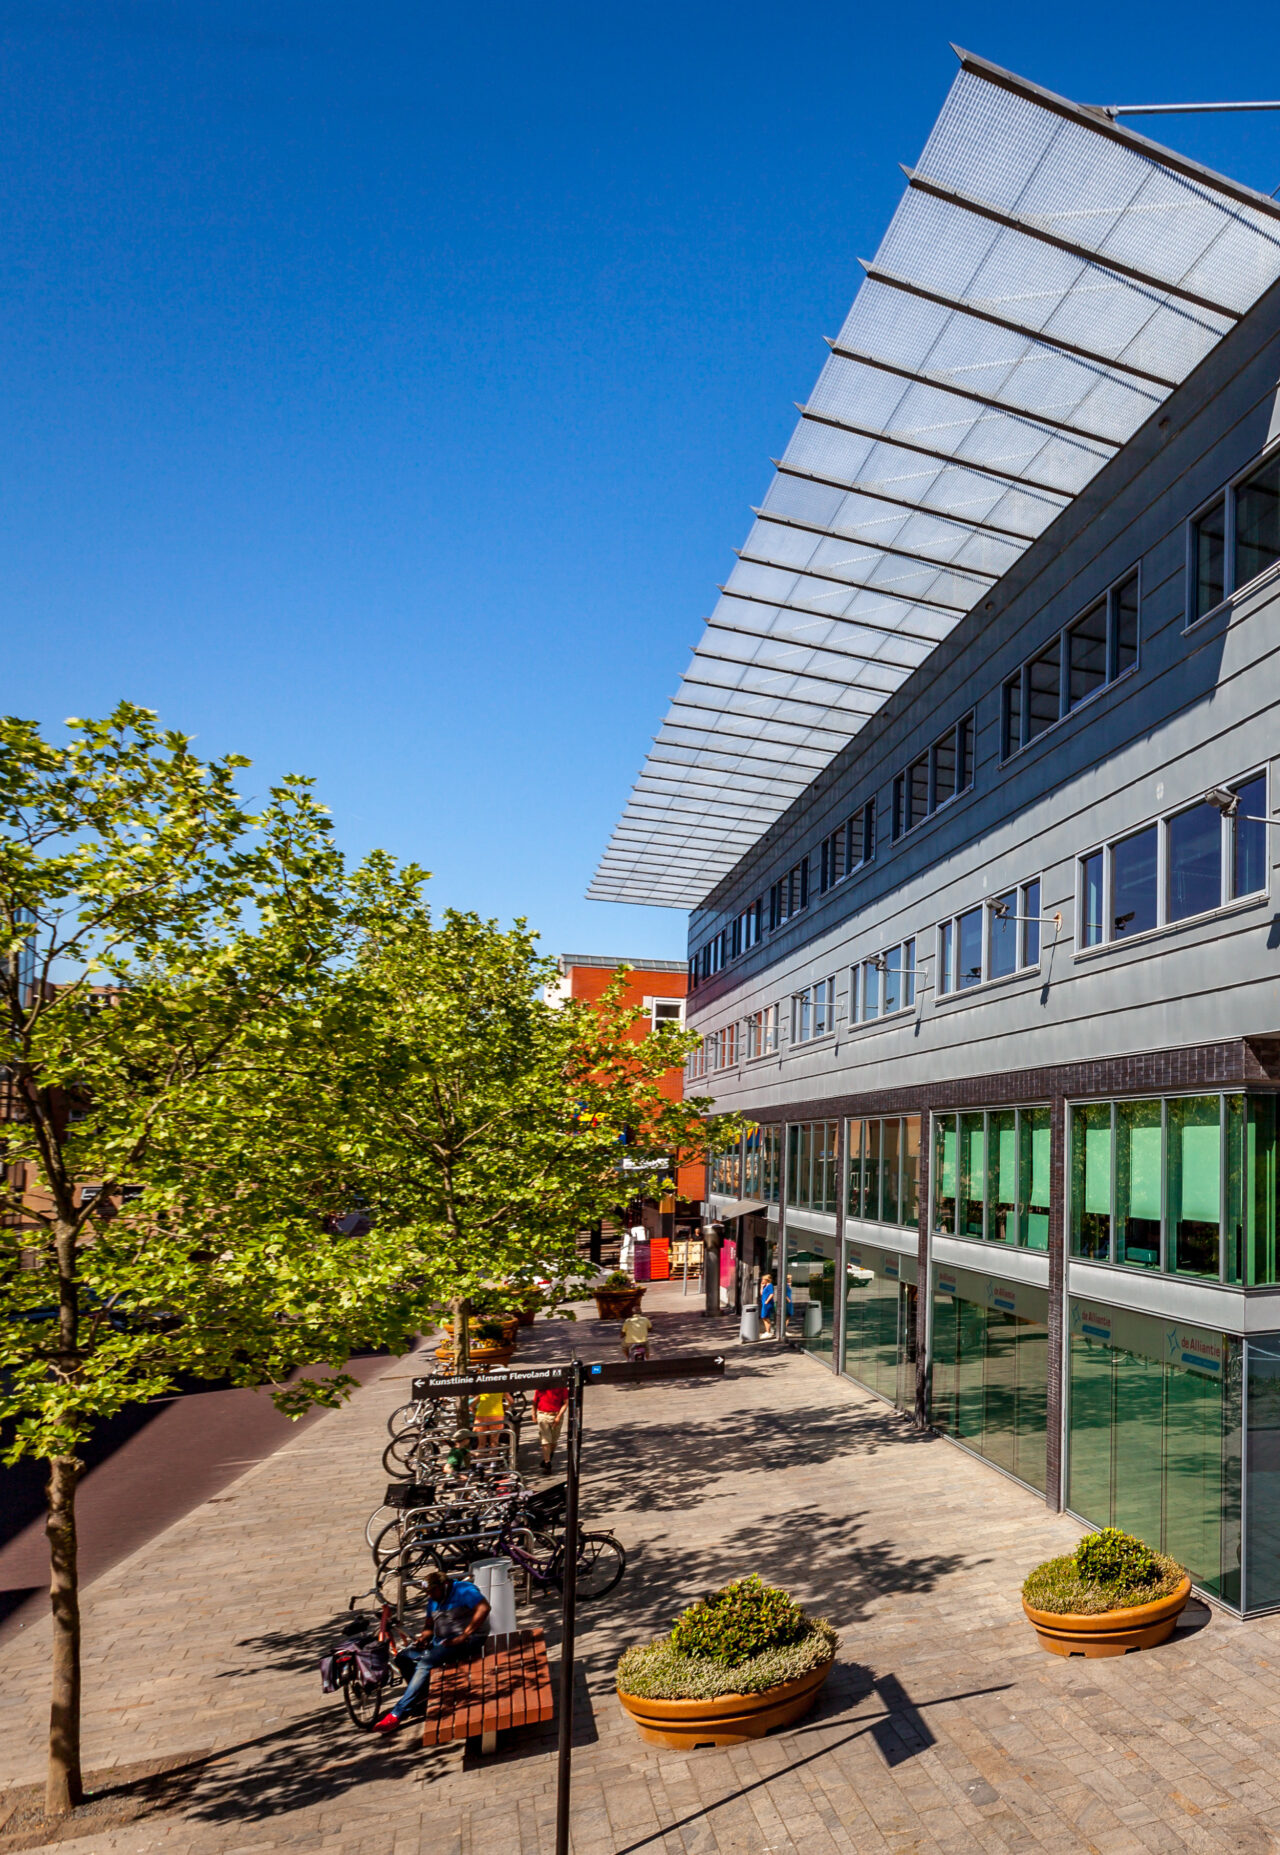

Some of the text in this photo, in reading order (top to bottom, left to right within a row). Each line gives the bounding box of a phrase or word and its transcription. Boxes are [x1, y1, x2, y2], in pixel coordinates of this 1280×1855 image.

[1181, 1336, 1220, 1357] de Alliantie
[429, 1370, 550, 1386] Kunstlinie Almere Flevoland
